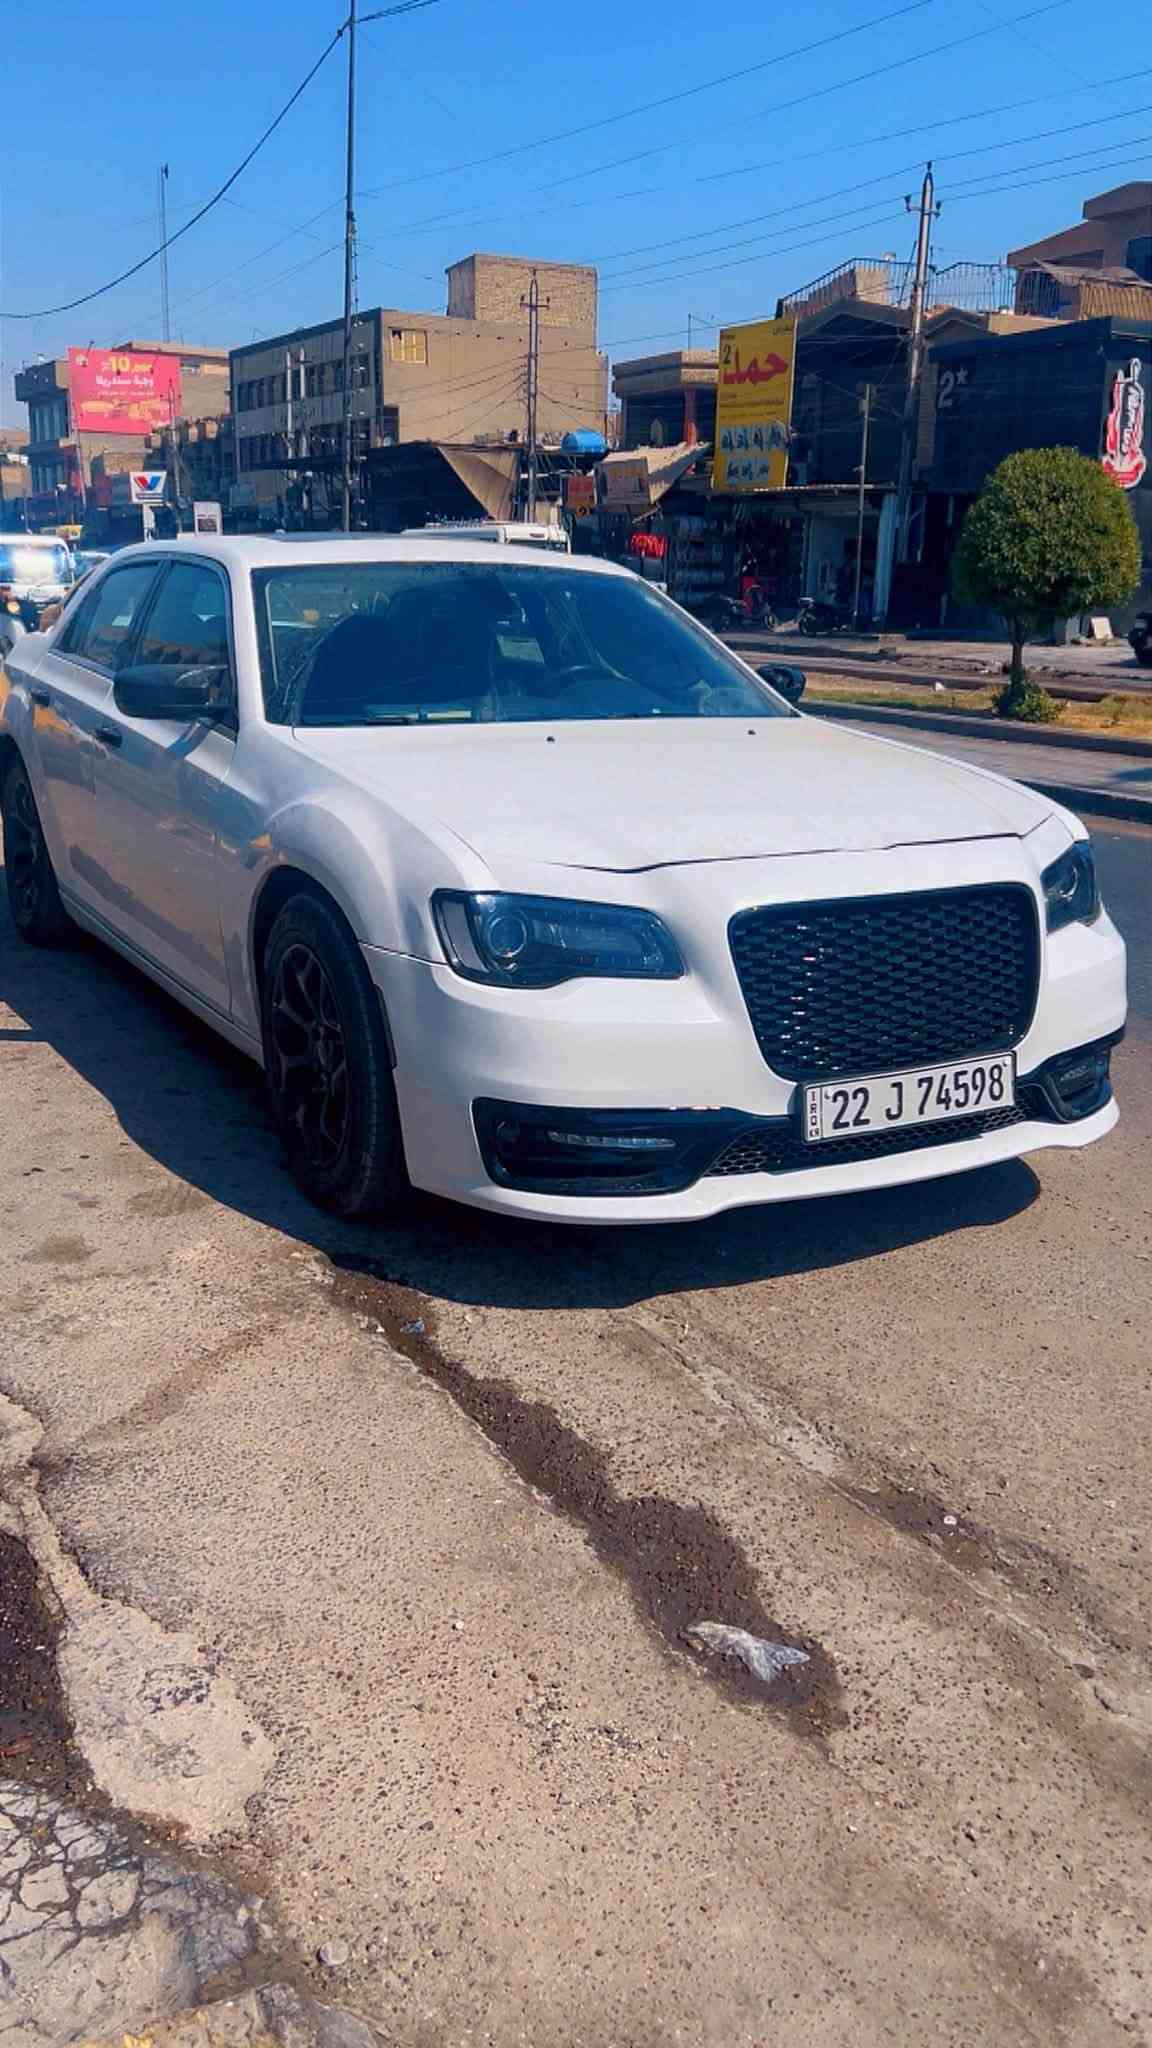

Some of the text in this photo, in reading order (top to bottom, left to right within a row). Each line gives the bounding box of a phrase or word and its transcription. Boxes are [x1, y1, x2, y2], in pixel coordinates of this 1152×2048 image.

[109, 355, 130, 372] 10
[831, 1063, 1005, 1130] 22 J 74598
